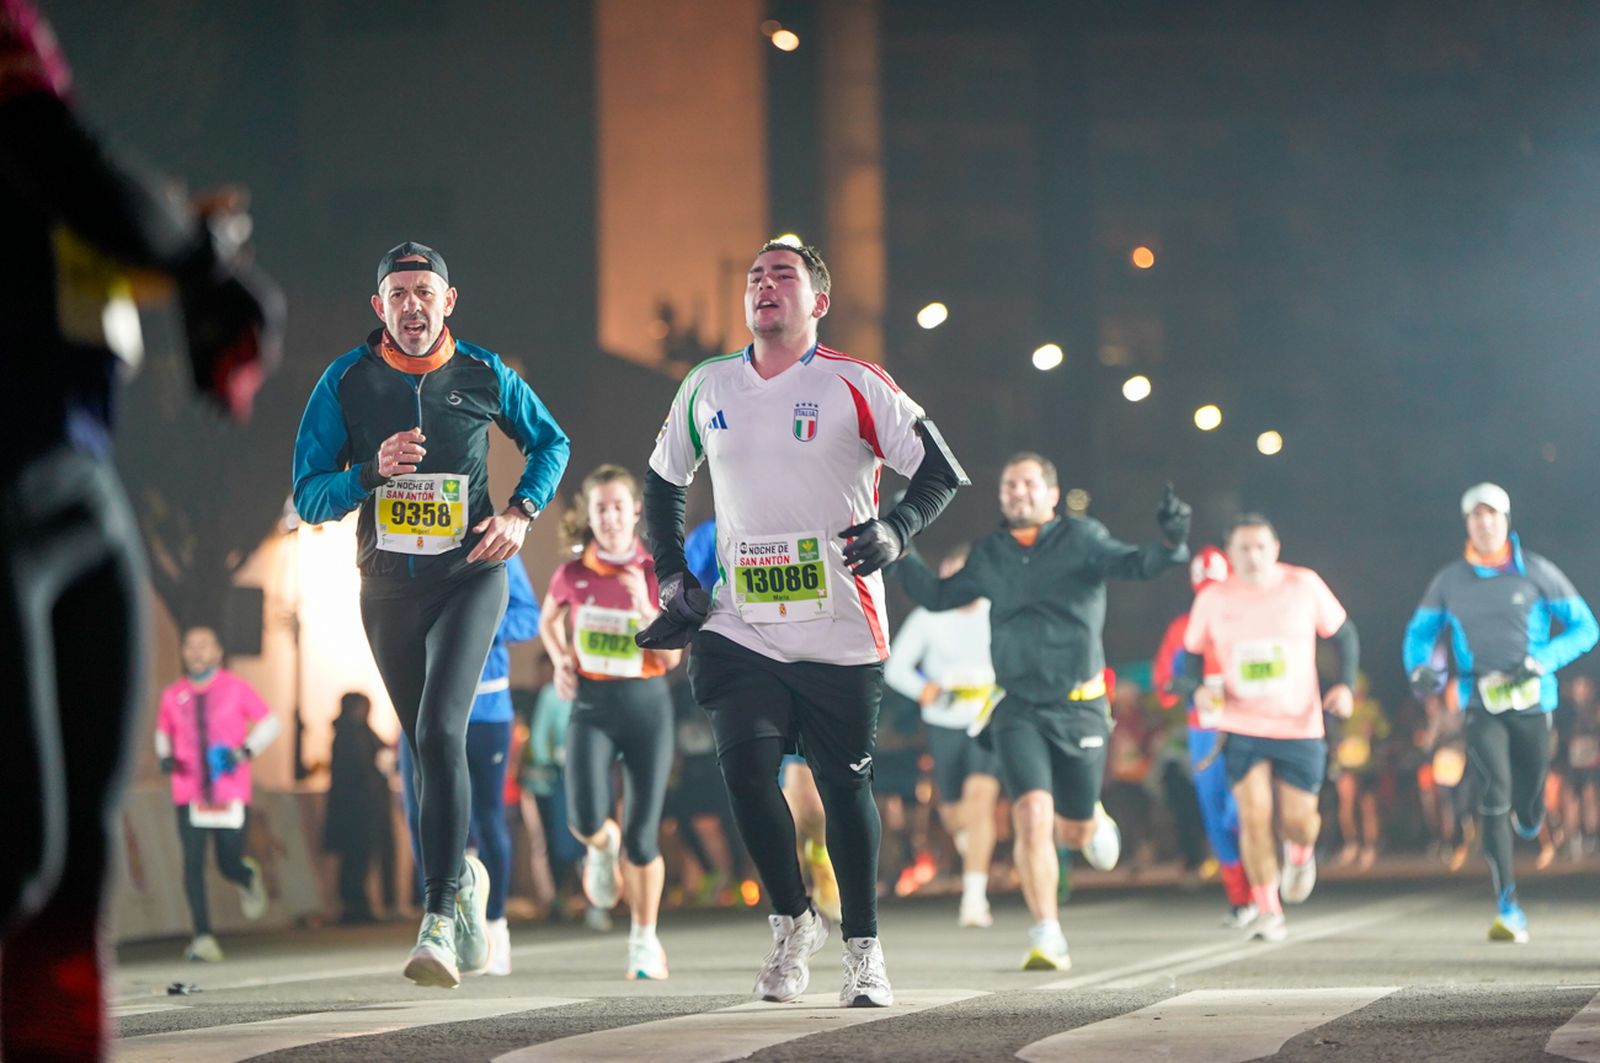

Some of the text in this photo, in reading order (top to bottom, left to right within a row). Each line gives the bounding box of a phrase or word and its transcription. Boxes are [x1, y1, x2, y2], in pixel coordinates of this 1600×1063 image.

[396, 481, 435, 491] NOCHE DE
[386, 490, 404, 500] SAN
[391, 501, 451, 527] 9358
[748, 545, 776, 555] NOCHE
[778, 544, 789, 553] DE
[740, 557, 757, 566] SAN
[742, 564, 819, 593] 13086
